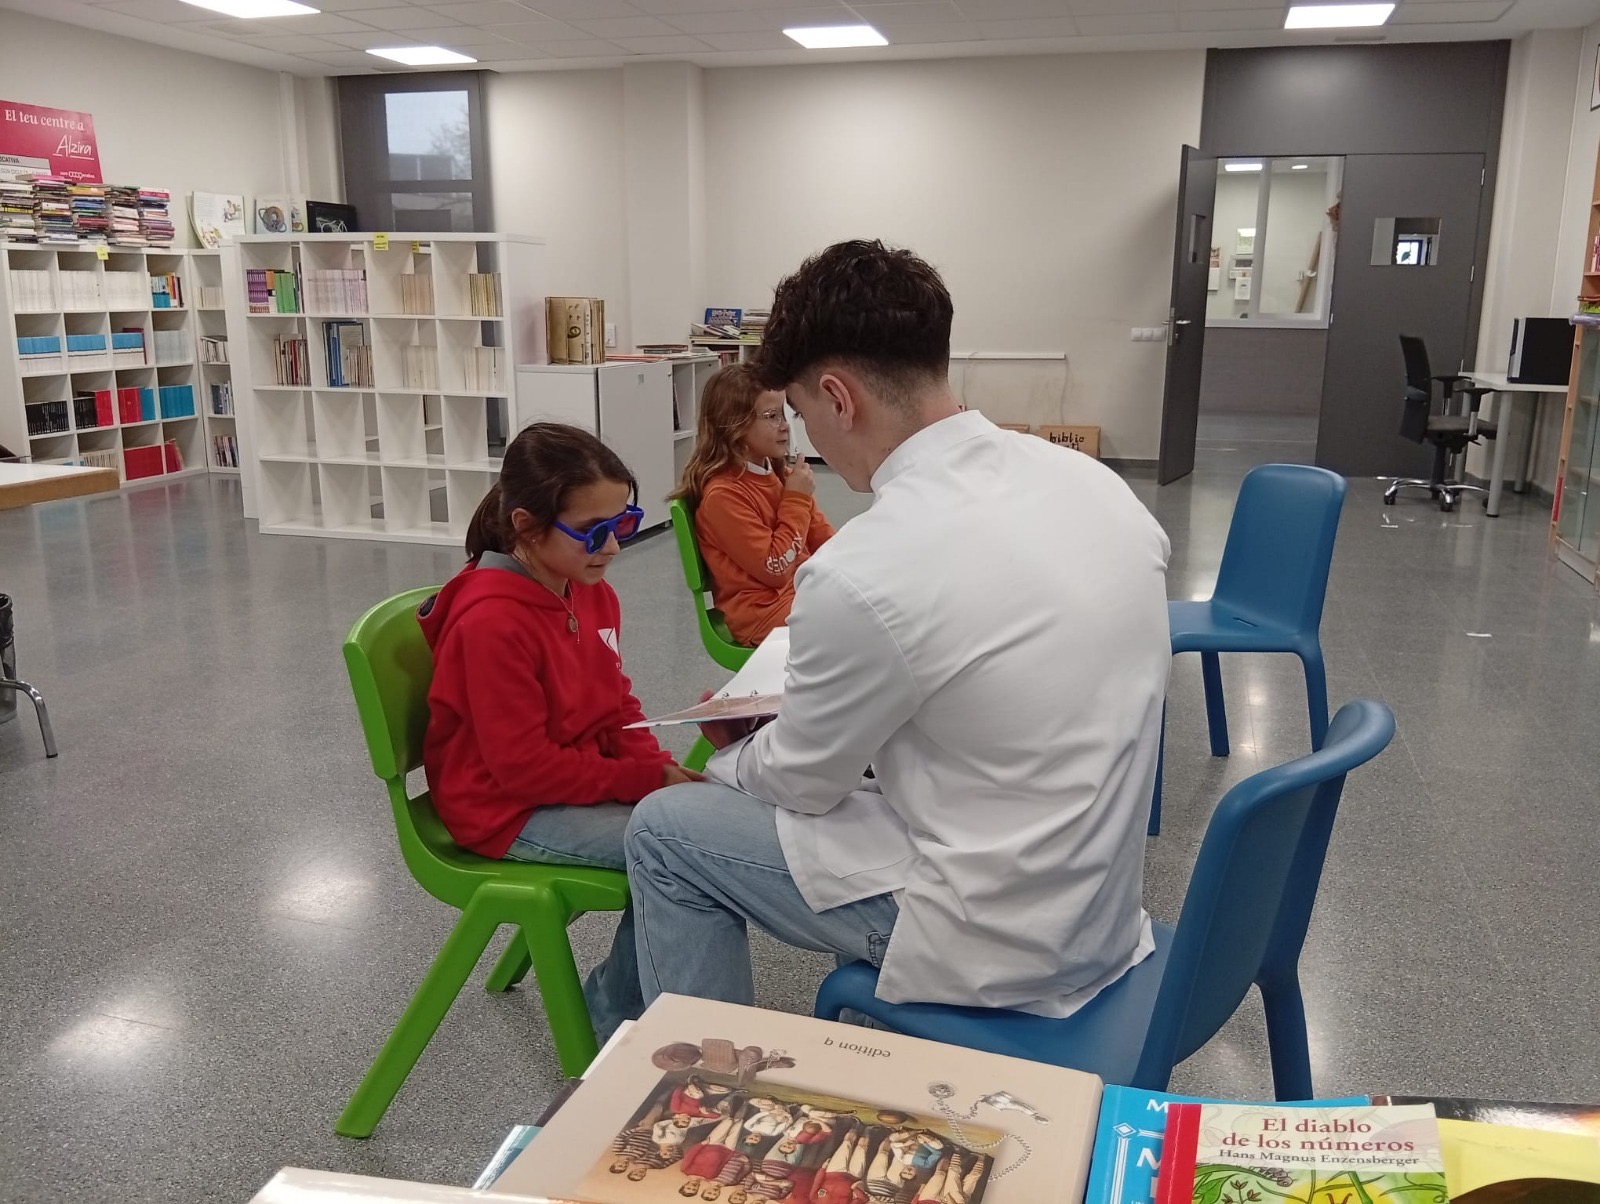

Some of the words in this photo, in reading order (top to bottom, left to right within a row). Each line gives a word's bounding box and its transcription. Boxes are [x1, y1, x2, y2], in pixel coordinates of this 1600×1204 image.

[5, 109, 17, 122] El
[19, 111, 38, 125] teu
[40, 116, 75, 130] centre
[77, 121, 84, 131] a
[55, 134, 92, 157] Alzira
[838, 1041, 891, 1058] edition
[1262, 1118, 1286, 1132] El
[1295, 1119, 1372, 1133] diablo
[1222, 1132, 1250, 1147] de
[1257, 1134, 1291, 1149] los
[1300, 1137, 1415, 1151] números
[1219, 1149, 1256, 1160] Hans
[1260, 1152, 1316, 1164] Magnus
[1321, 1154, 1420, 1167] Enzensberger
